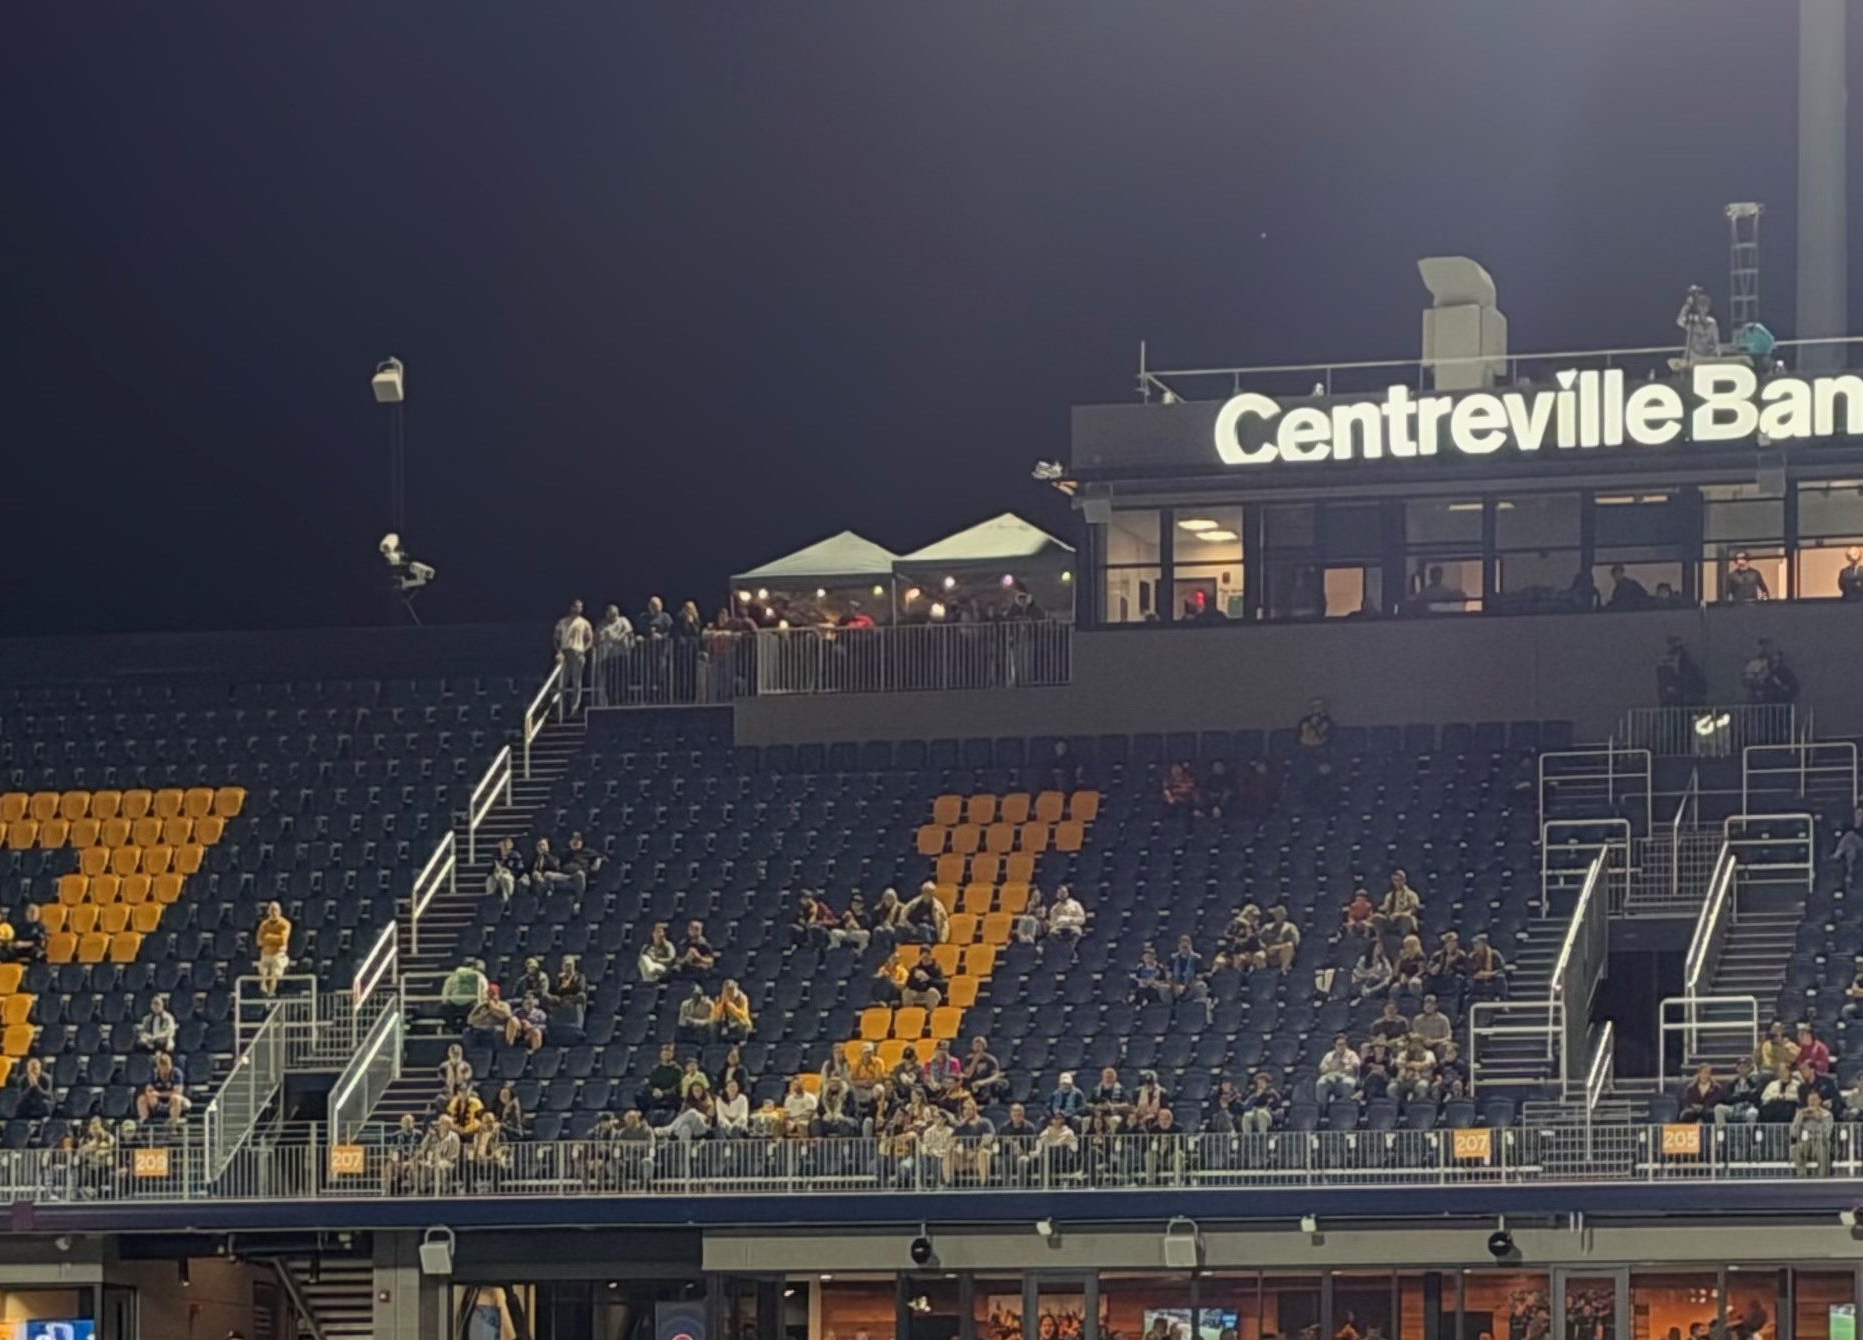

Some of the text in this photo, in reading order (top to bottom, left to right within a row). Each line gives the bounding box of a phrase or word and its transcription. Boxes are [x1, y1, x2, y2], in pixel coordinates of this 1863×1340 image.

[1214, 369, 1683, 465] Centreville
[1456, 1135, 1488, 1151] 207
[1665, 1131, 1698, 1148] 205
[332, 1152, 362, 1168] 207
